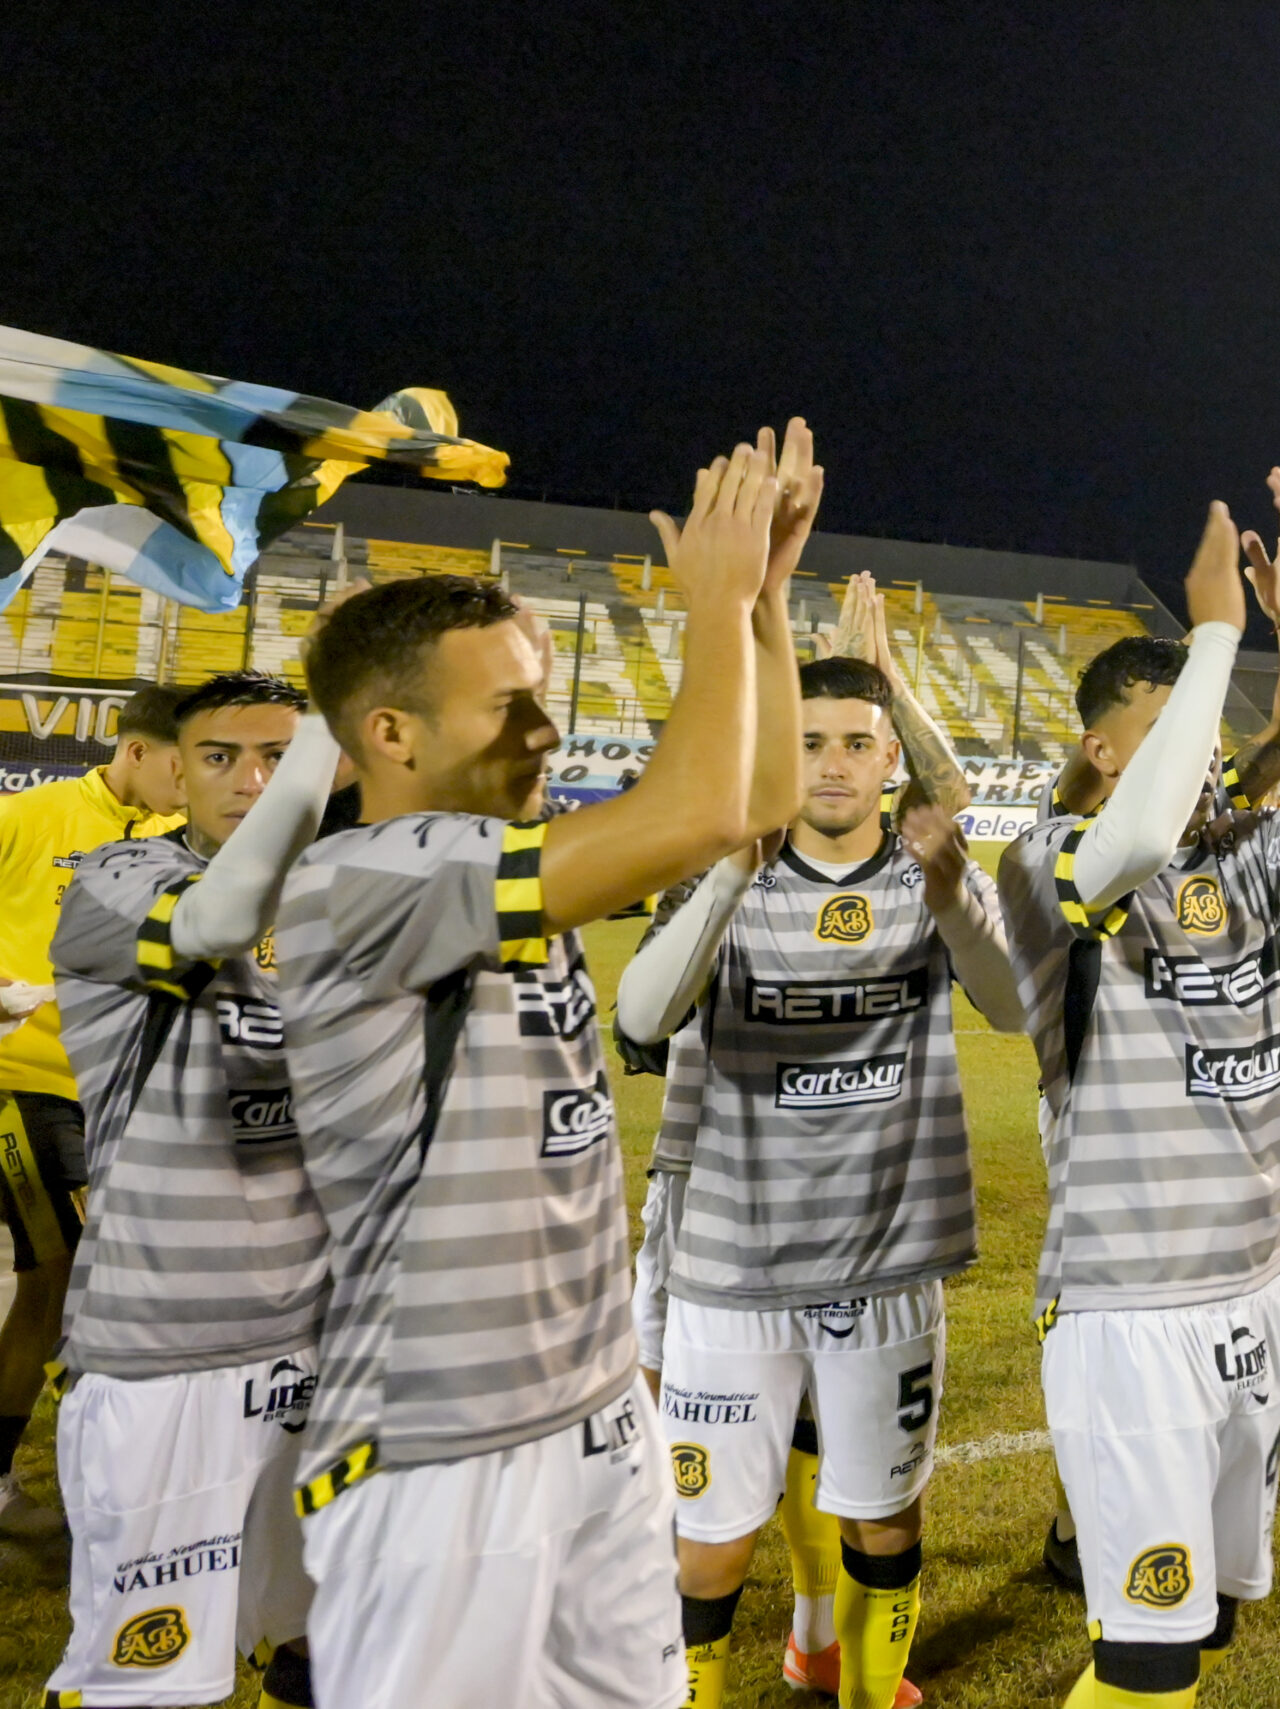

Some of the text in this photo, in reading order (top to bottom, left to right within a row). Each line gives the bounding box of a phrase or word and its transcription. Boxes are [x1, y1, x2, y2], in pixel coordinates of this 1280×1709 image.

[53, 857, 79, 869] RET
[752, 979, 923, 1020] RETIEL
[780, 1061, 905, 1096] CartaSur
[898, 1359, 933, 1433] 5
